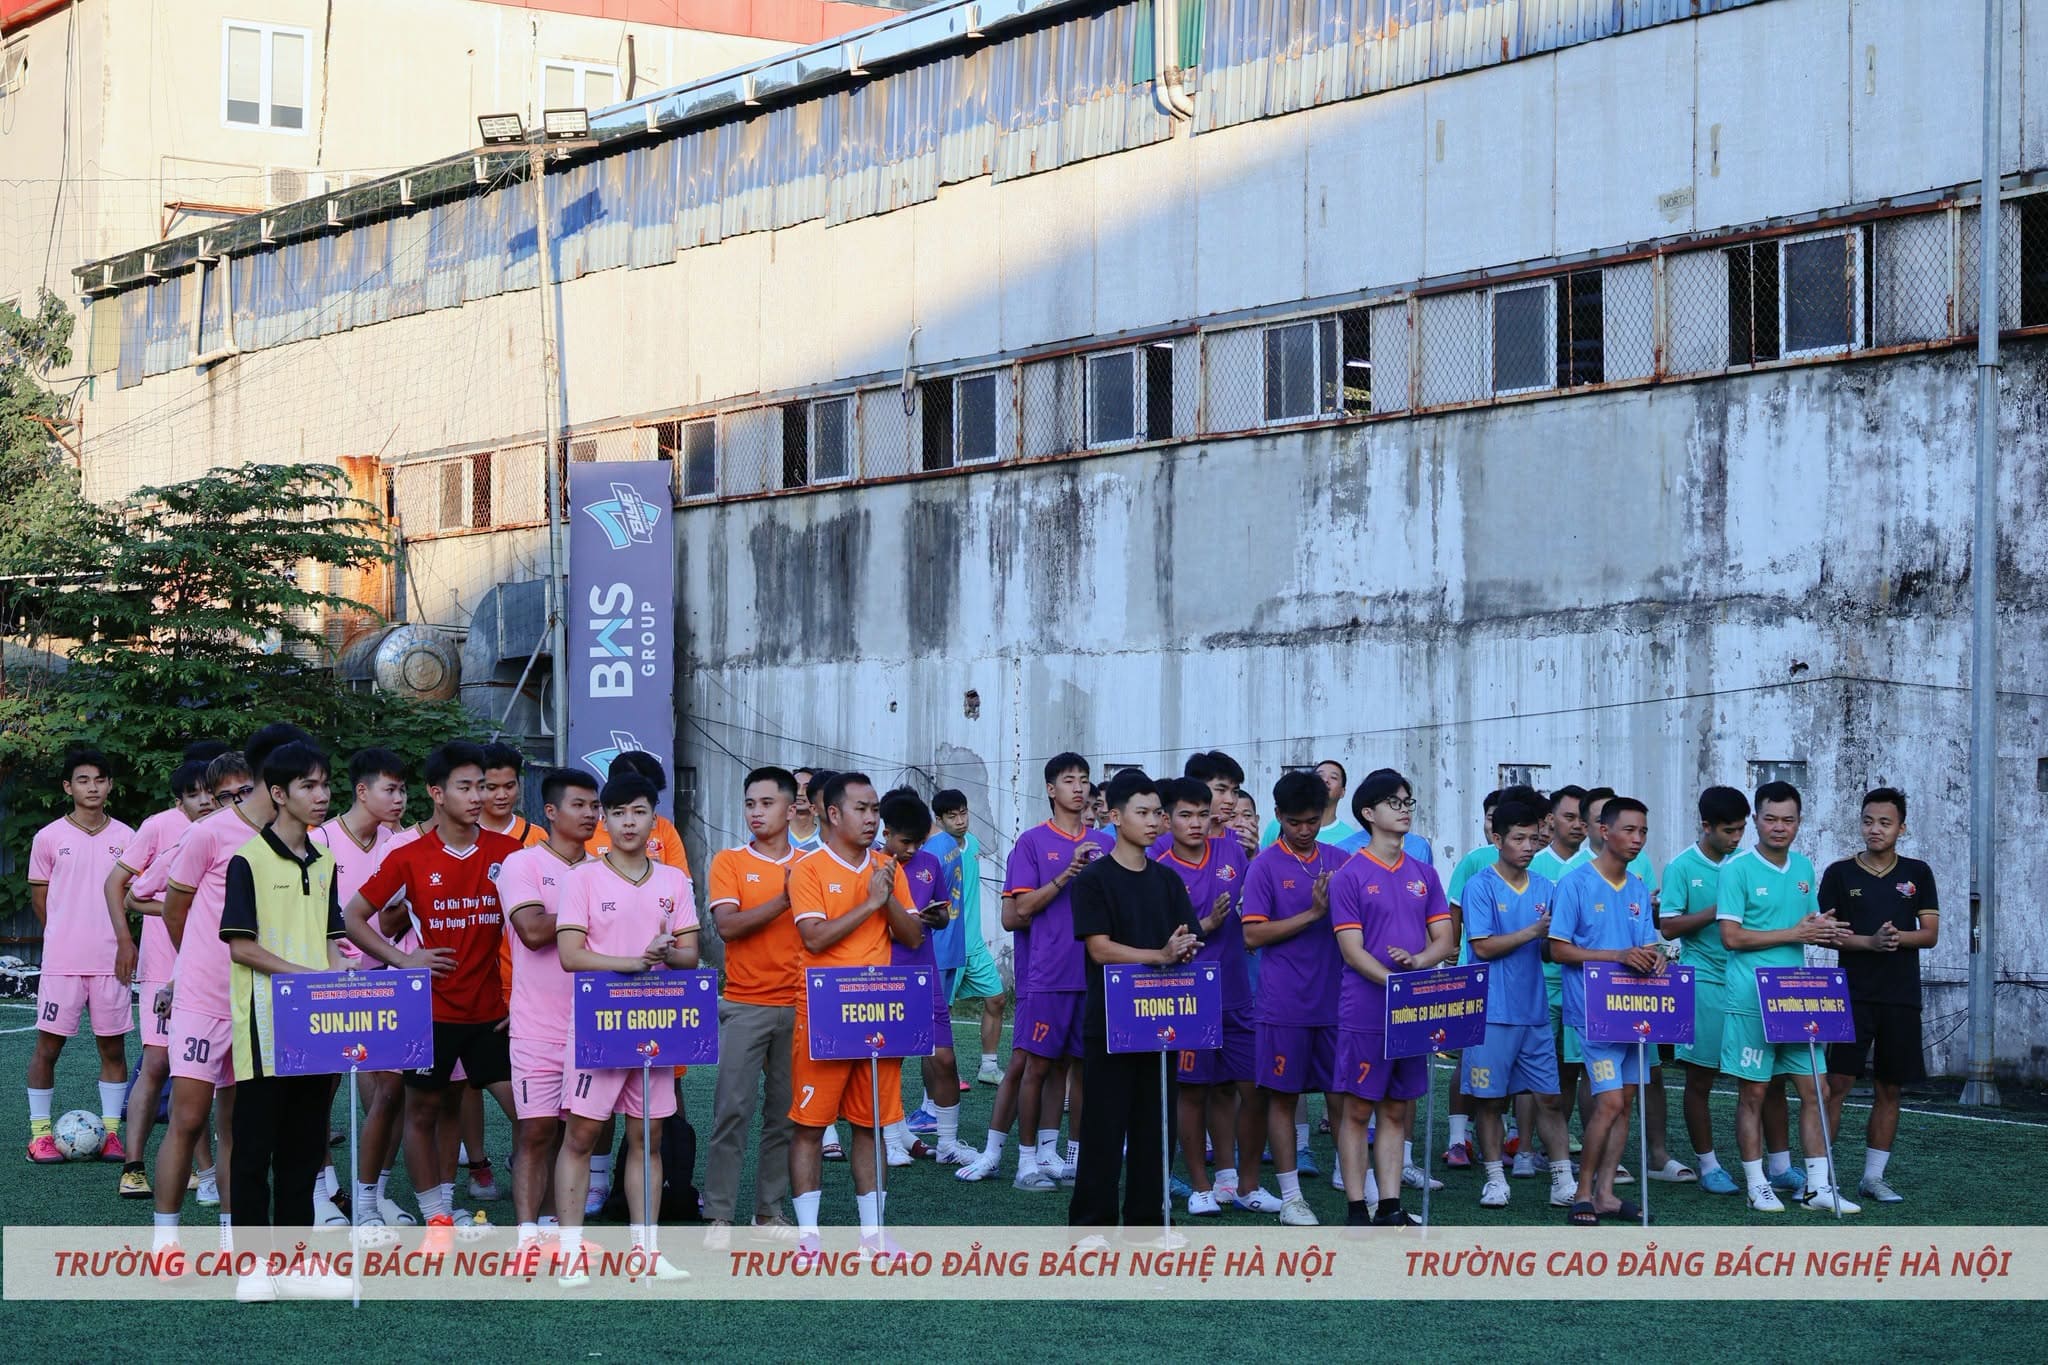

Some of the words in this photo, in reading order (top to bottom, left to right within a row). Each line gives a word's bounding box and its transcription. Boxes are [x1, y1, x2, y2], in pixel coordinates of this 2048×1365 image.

[1663, 194, 1689, 208] NORTH
[616, 489, 646, 535] BLUE
[641, 601, 655, 677] GROUP
[482, 895, 496, 907] Yên
[429, 917, 444, 931] Xây
[478, 912, 500, 925] HOME
[311, 990, 347, 1000] HACINCO
[349, 989, 372, 999] OPEN
[373, 987, 395, 998] 2026
[1606, 994, 1658, 1013] HACINCO
[1661, 996, 1676, 1013] FC
[42, 1001, 59, 1022] 19
[841, 1003, 885, 1023] FECON
[888, 1002, 905, 1021] FC
[1133, 997, 1175, 1021] TRỌNG
[1178, 993, 1197, 1015] TÀI
[1429, 1002, 1447, 1020] BÁCH
[1447, 998, 1465, 1019] NGHỆ
[1476, 998, 1484, 1014] FC
[1767, 998, 1778, 1012] CA
[309, 1011, 372, 1034] SUNJIN
[378, 1009, 398, 1031] FC
[595, 1010, 622, 1031] TBT
[627, 1008, 677, 1030] GROUP
[681, 1008, 700, 1028] FC
[1032, 1021, 1050, 1042] 17
[183, 1036, 210, 1064] 30
[1740, 1046, 1764, 1069] 94
[1179, 1051, 1196, 1072] 10
[1273, 1055, 1286, 1077] 3
[1357, 1062, 1371, 1084] 7
[522, 1080, 528, 1104] 1
[575, 1072, 592, 1099] 11
[800, 1085, 815, 1109] 7
